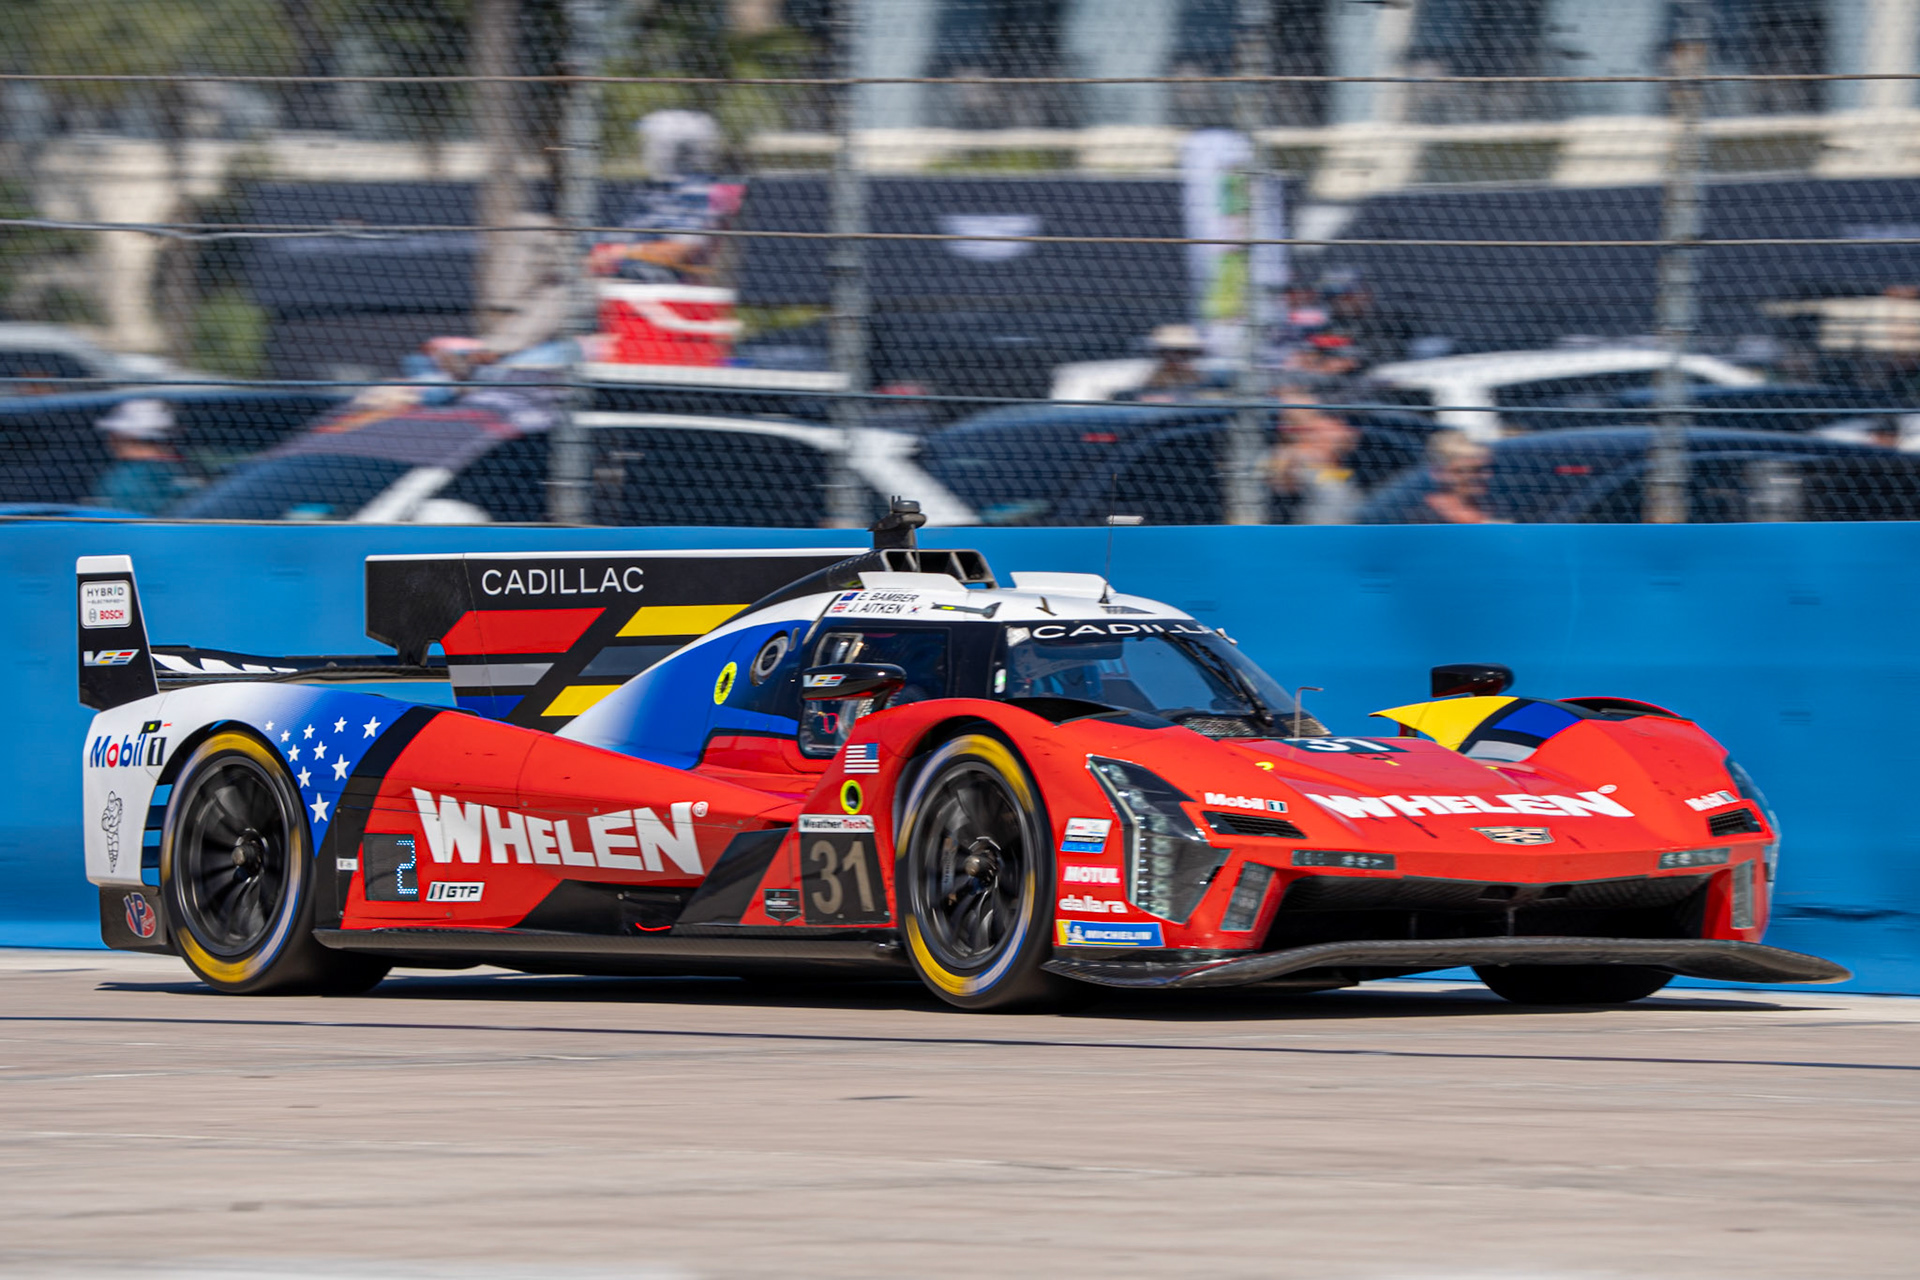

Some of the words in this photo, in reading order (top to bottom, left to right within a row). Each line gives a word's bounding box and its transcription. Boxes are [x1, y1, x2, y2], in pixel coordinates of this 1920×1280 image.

[481, 566, 645, 596] CADILLAC
[87, 586, 124, 598] HYBRID
[870, 592, 920, 602] BAMBER
[99, 609, 125, 620] BOSCH
[848, 603, 859, 613] J.
[860, 602, 905, 614] AITKEN
[1032, 624, 1213, 639] CADILL
[89, 733, 148, 768] Mobil
[1283, 738, 1391, 752] 31
[1204, 792, 1265, 810] Mobil
[1304, 790, 1636, 819] WHELEN
[411, 786, 705, 876] WHELEN
[803, 819, 867, 830] WeatherTech
[396, 840, 417, 895] 2
[1063, 866, 1120, 884] MOTUL
[809, 839, 875, 915] 31
[446, 884, 480, 899] GTP
[1084, 929, 1153, 941] MICHELIN
